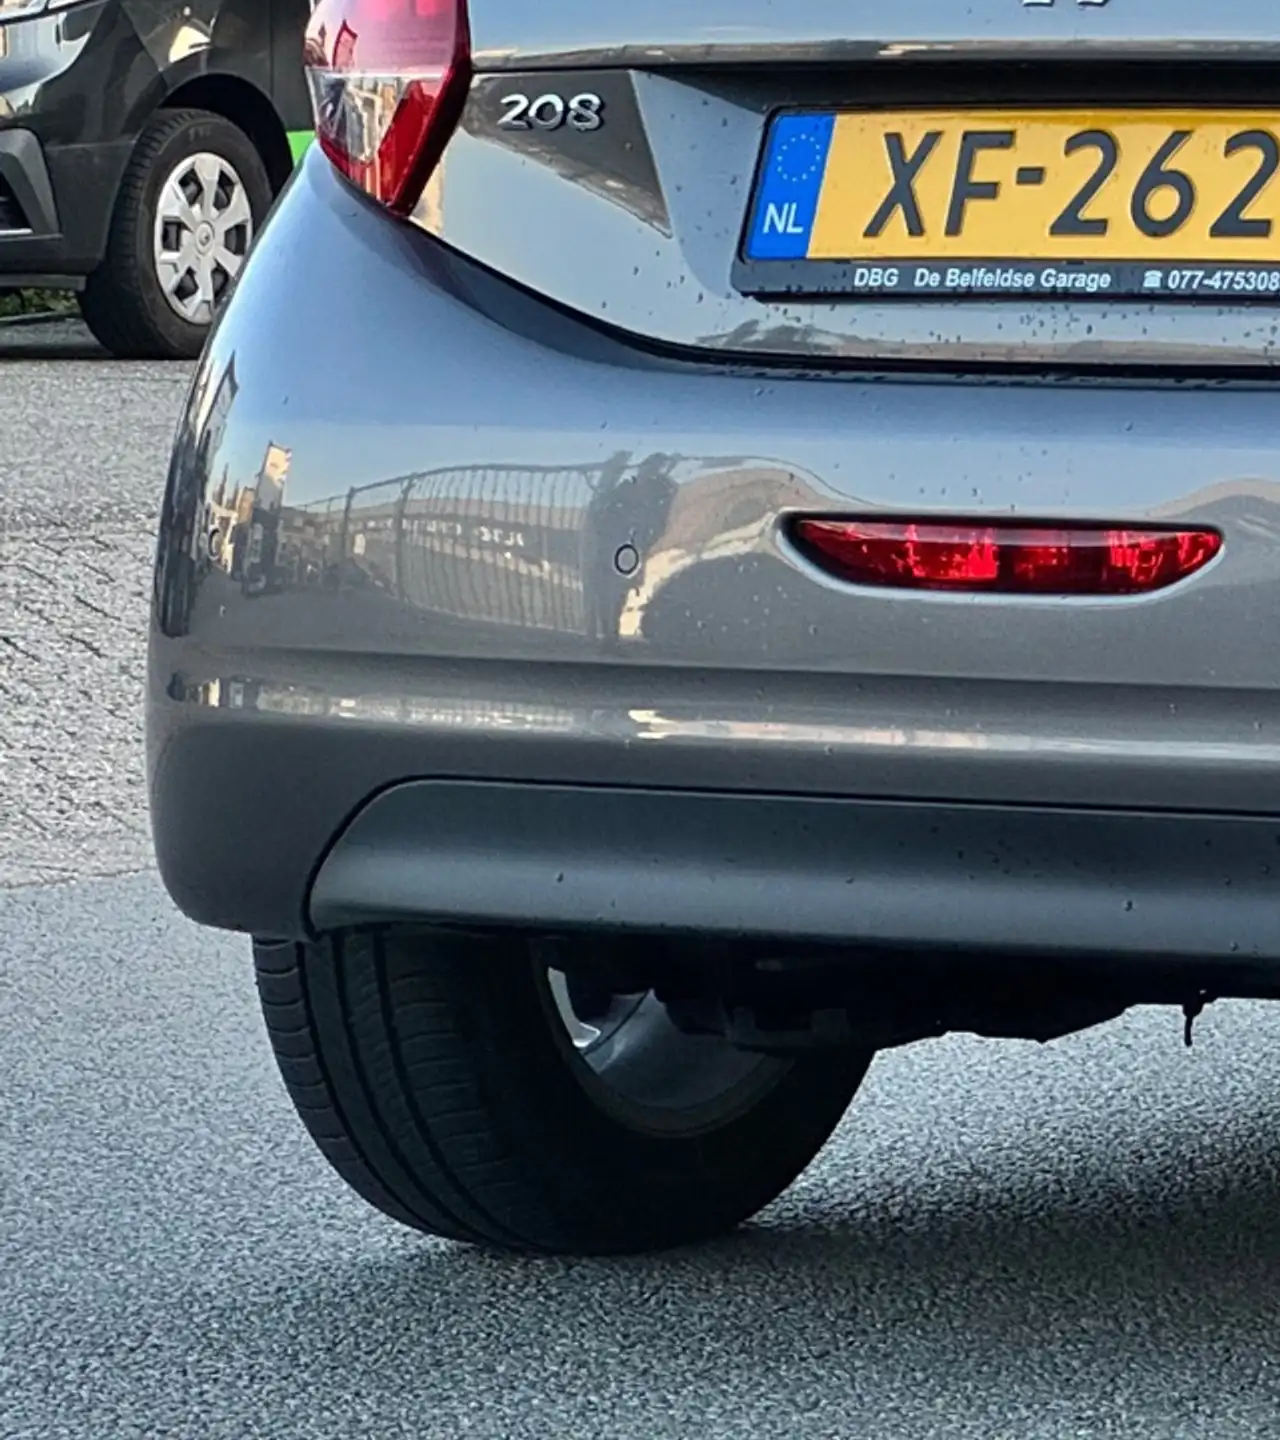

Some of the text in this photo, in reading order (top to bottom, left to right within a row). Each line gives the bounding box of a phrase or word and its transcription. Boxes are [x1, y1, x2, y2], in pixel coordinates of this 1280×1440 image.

[496, 92, 602, 131] 208
[762, 202, 805, 235] NL
[853, 267, 900, 288] DBG
[914, 267, 941, 288] De
[945, 267, 1036, 288] Belfeldse
[1040, 267, 1112, 292] Garage
